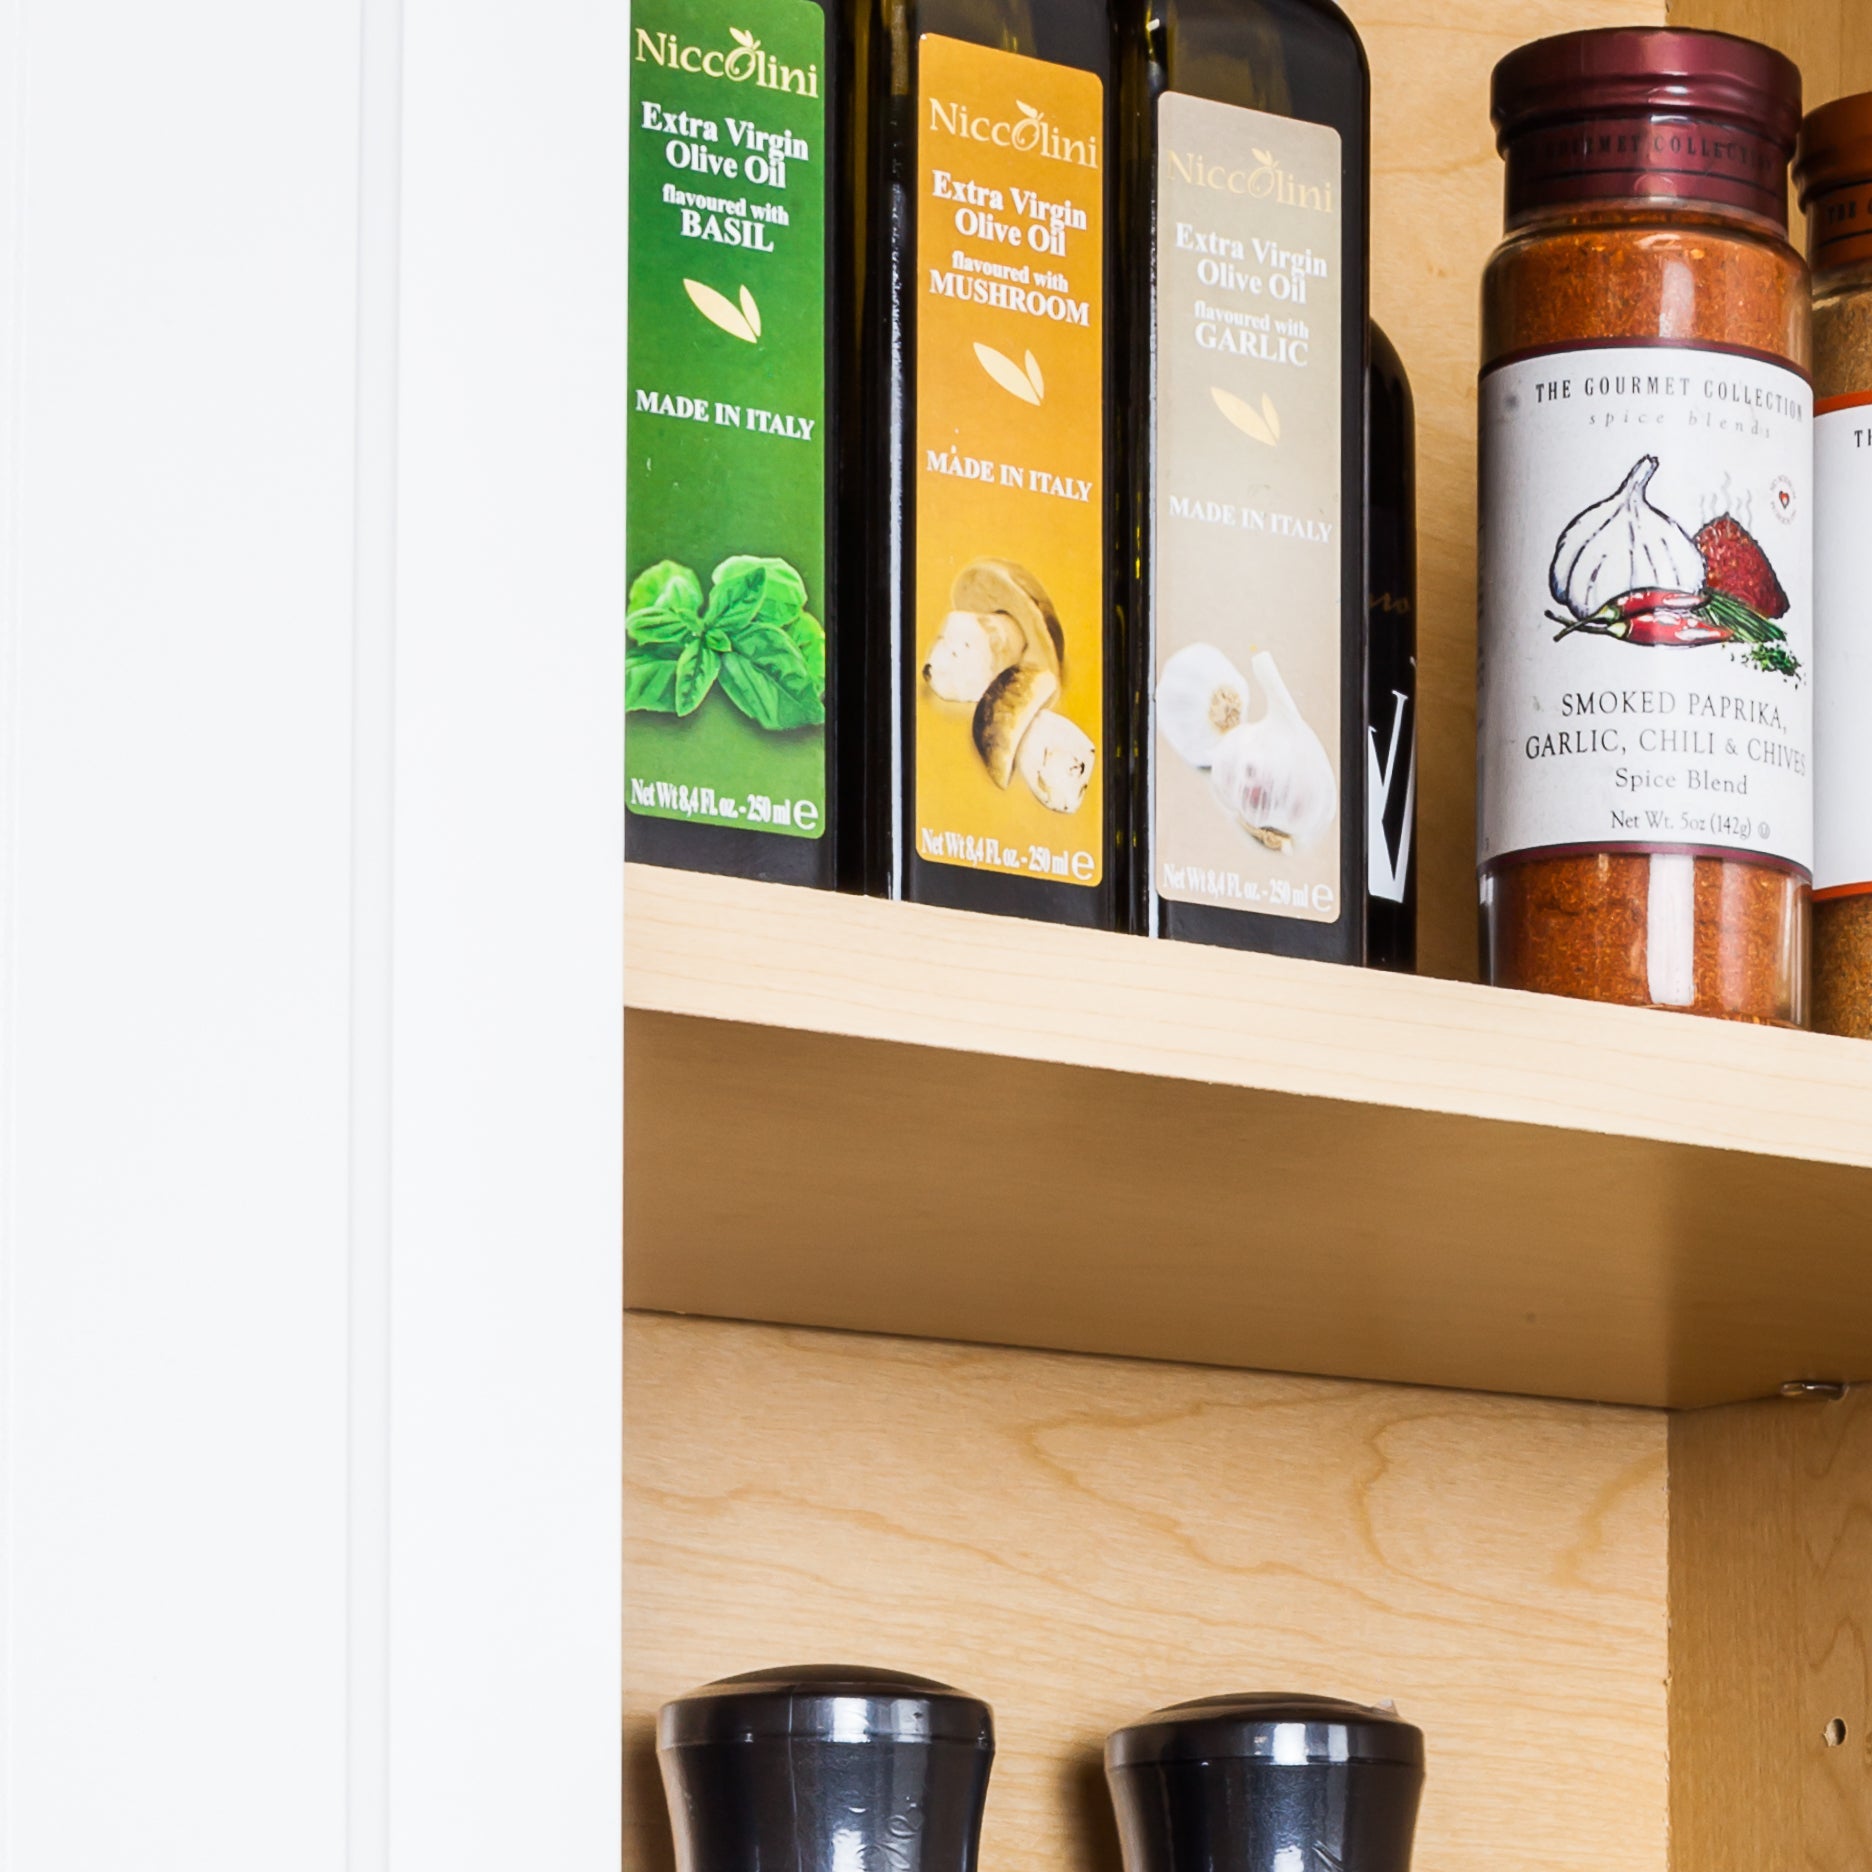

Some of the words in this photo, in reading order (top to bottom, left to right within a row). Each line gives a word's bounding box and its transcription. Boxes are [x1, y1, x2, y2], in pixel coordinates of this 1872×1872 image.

[641, 102, 718, 142] Extra
[725, 117, 809, 166] Virgin
[666, 140, 738, 178] Olive
[744, 155, 786, 188] Oil
[662, 183, 746, 217] flavoured
[750, 203, 789, 226] with
[932, 169, 1004, 211] Extra
[1009, 187, 1087, 231] Virgin
[1827, 201, 1857, 224] THE
[680, 209, 774, 252] BASIL
[955, 208, 1022, 246] Olive
[1028, 224, 1066, 257] Oil
[1175, 222, 1244, 260] Extra
[1251, 237, 1328, 278] Virgin
[952, 250, 1030, 284] flavoured
[1033, 271, 1069, 293] with
[1197, 259, 1262, 295] Olive
[1269, 273, 1307, 304] Oil
[929, 269, 1090, 327] MUSHROOM
[1194, 300, 1270, 332] flavoured
[1274, 318, 1309, 340] with
[1195, 322, 1308, 367] GARLIC
[635, 389, 709, 423] MADE
[714, 402, 741, 428] IN
[746, 408, 815, 441] ITALY
[1536, 380, 1571, 403] THE
[1584, 376, 1690, 397] GOURMET
[1704, 379, 1804, 423] COLLECTION
[1589, 410, 1665, 429] spice
[1689, 410, 1770, 439] blends
[926, 450, 995, 483] MADE
[999, 464, 1024, 488] IN
[1029, 470, 1093, 502] ITALY
[1169, 495, 1236, 526] MADE
[1241, 507, 1265, 531] IN
[1271, 513, 1333, 544] ITALY
[1562, 690, 1676, 717] SMOKED
[1689, 692, 1787, 735] PAPRIKA,
[1525, 728, 1627, 760] GARLIC,
[1639, 728, 1714, 755] CHILI
[1725, 737, 1738, 756] &
[1748, 737, 1807, 777] CHIVES
[631, 778, 656, 807] Net
[656, 781, 679, 811] Wt
[679, 785, 699, 817] 8,4
[747, 794, 772, 824] 250
[773, 799, 791, 826] ml
[1615, 767, 1676, 792] Spice
[1688, 769, 1747, 795] Blend
[1610, 810, 1639, 830] Net
[1645, 811, 1674, 831] Wt.
[1681, 811, 1706, 831] 5oz
[1710, 812, 1752, 840] (142g)
[921, 827, 944, 856] Net
[945, 831, 966, 860] Wt
[966, 835, 984, 866] 8,4
[1028, 845, 1051, 873] 250
[1052, 851, 1069, 876] ml
[1163, 863, 1185, 889] Net
[1269, 878, 1291, 906] 250
[1292, 883, 1309, 908] ml
